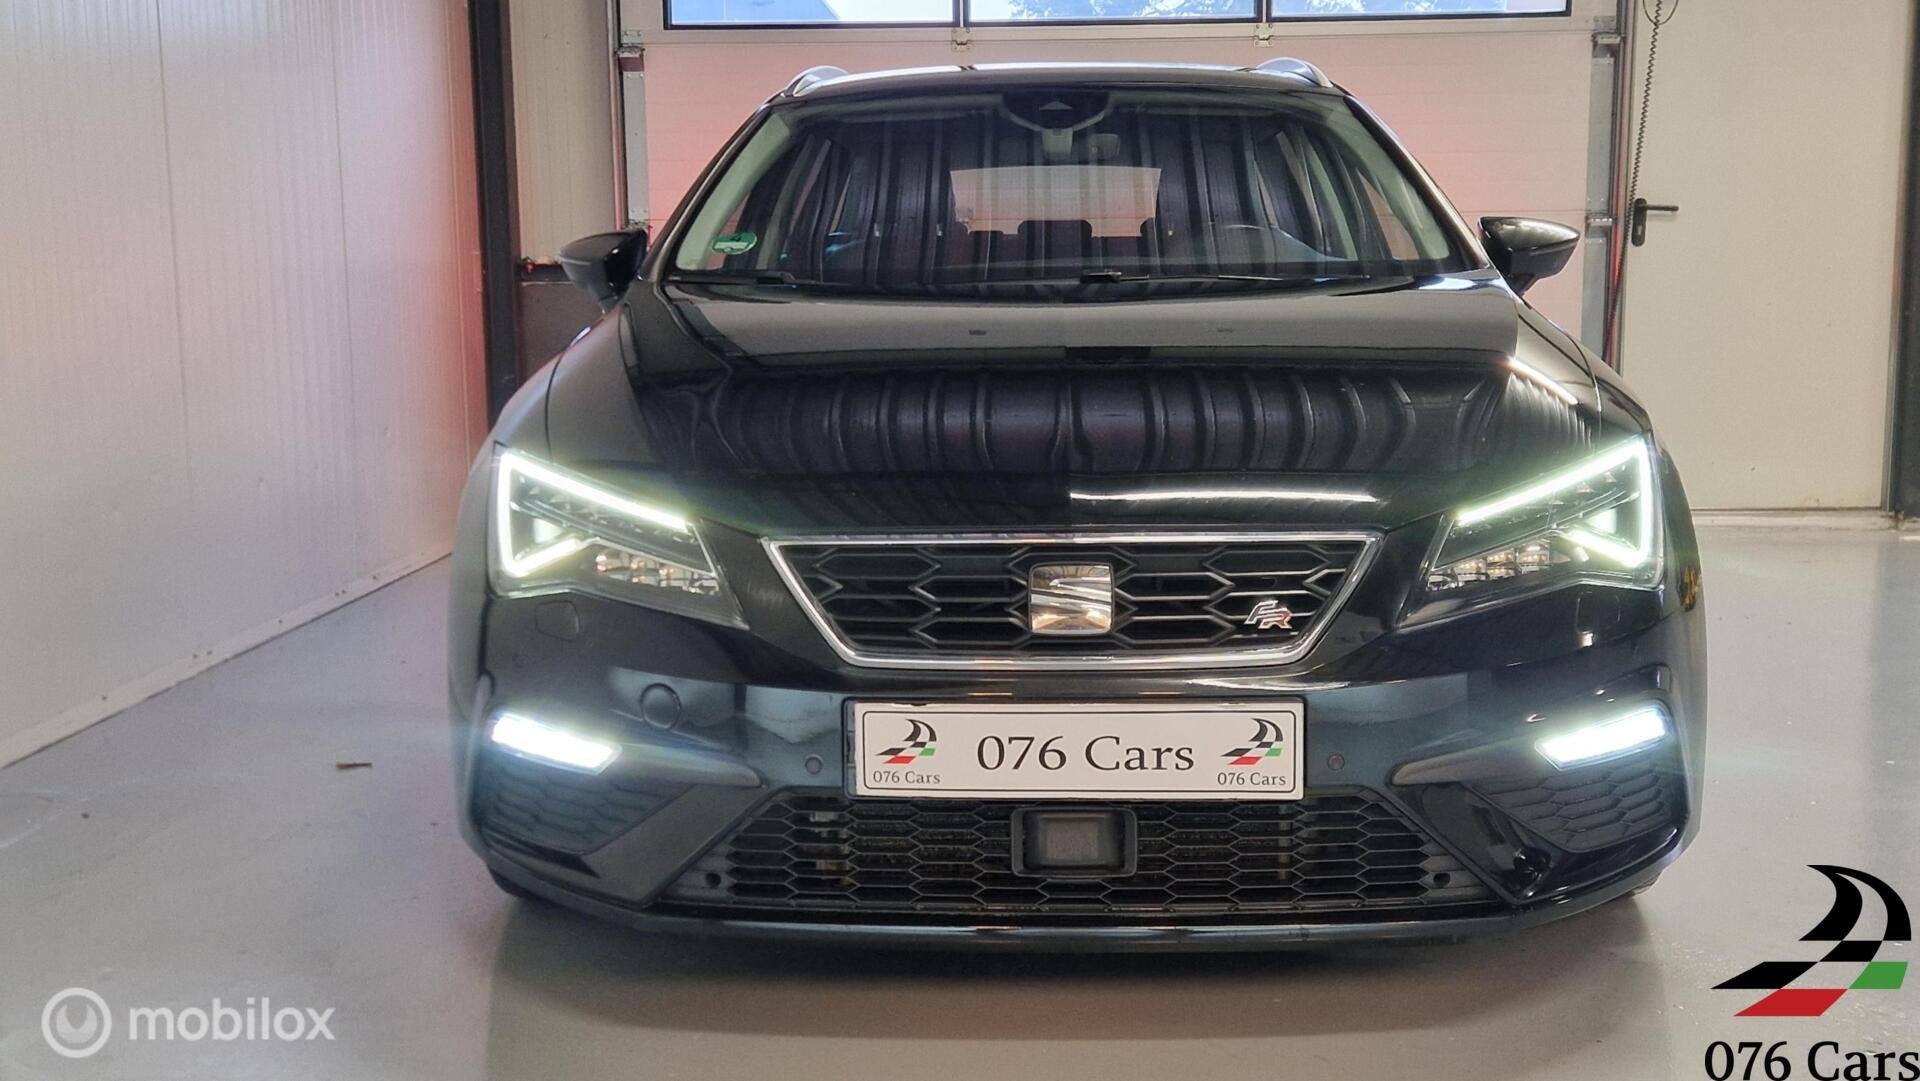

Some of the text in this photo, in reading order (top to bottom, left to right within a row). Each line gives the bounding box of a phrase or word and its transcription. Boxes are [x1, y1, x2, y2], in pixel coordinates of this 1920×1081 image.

[1244, 600, 1293, 629] FR
[977, 735, 1194, 771] 076 Cars
[872, 771, 941, 784] 076 Cars
[1217, 772, 1286, 786] 076 Cars
